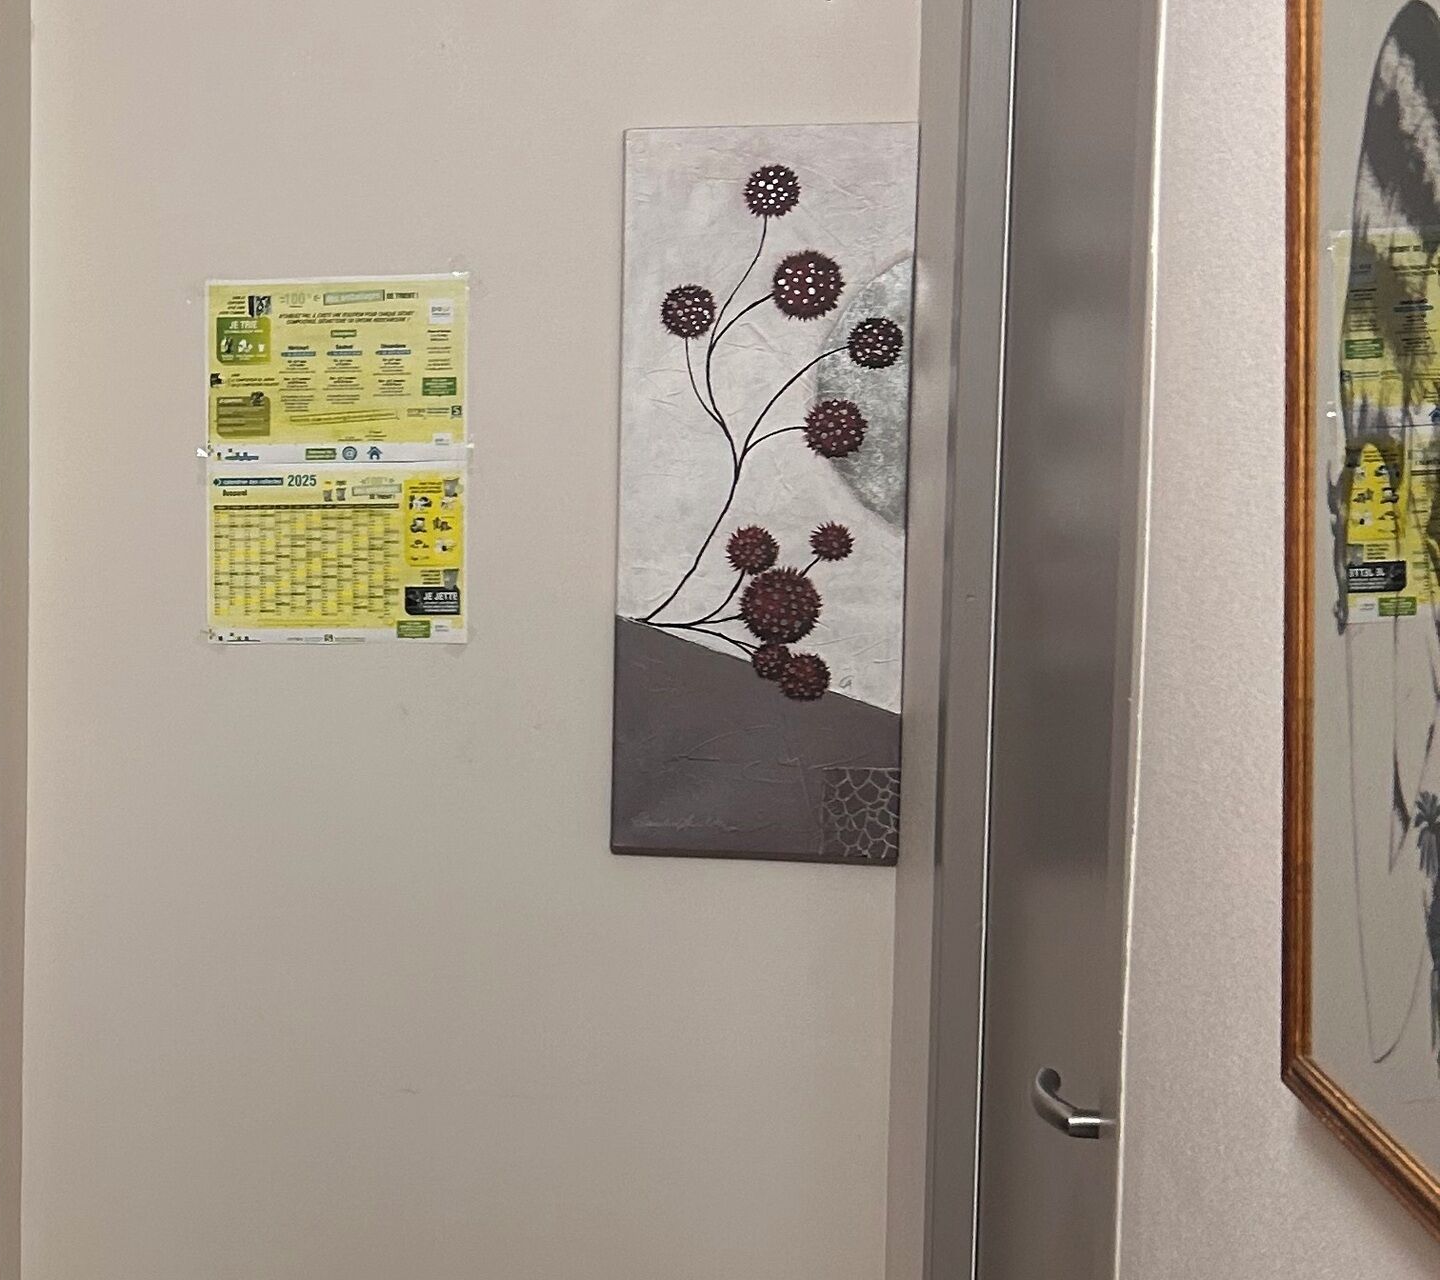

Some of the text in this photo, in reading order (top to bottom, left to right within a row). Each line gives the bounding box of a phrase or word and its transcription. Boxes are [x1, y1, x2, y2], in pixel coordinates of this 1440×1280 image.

[287, 474, 317, 487] 2025
[423, 591, 458, 601] JE JETTE
